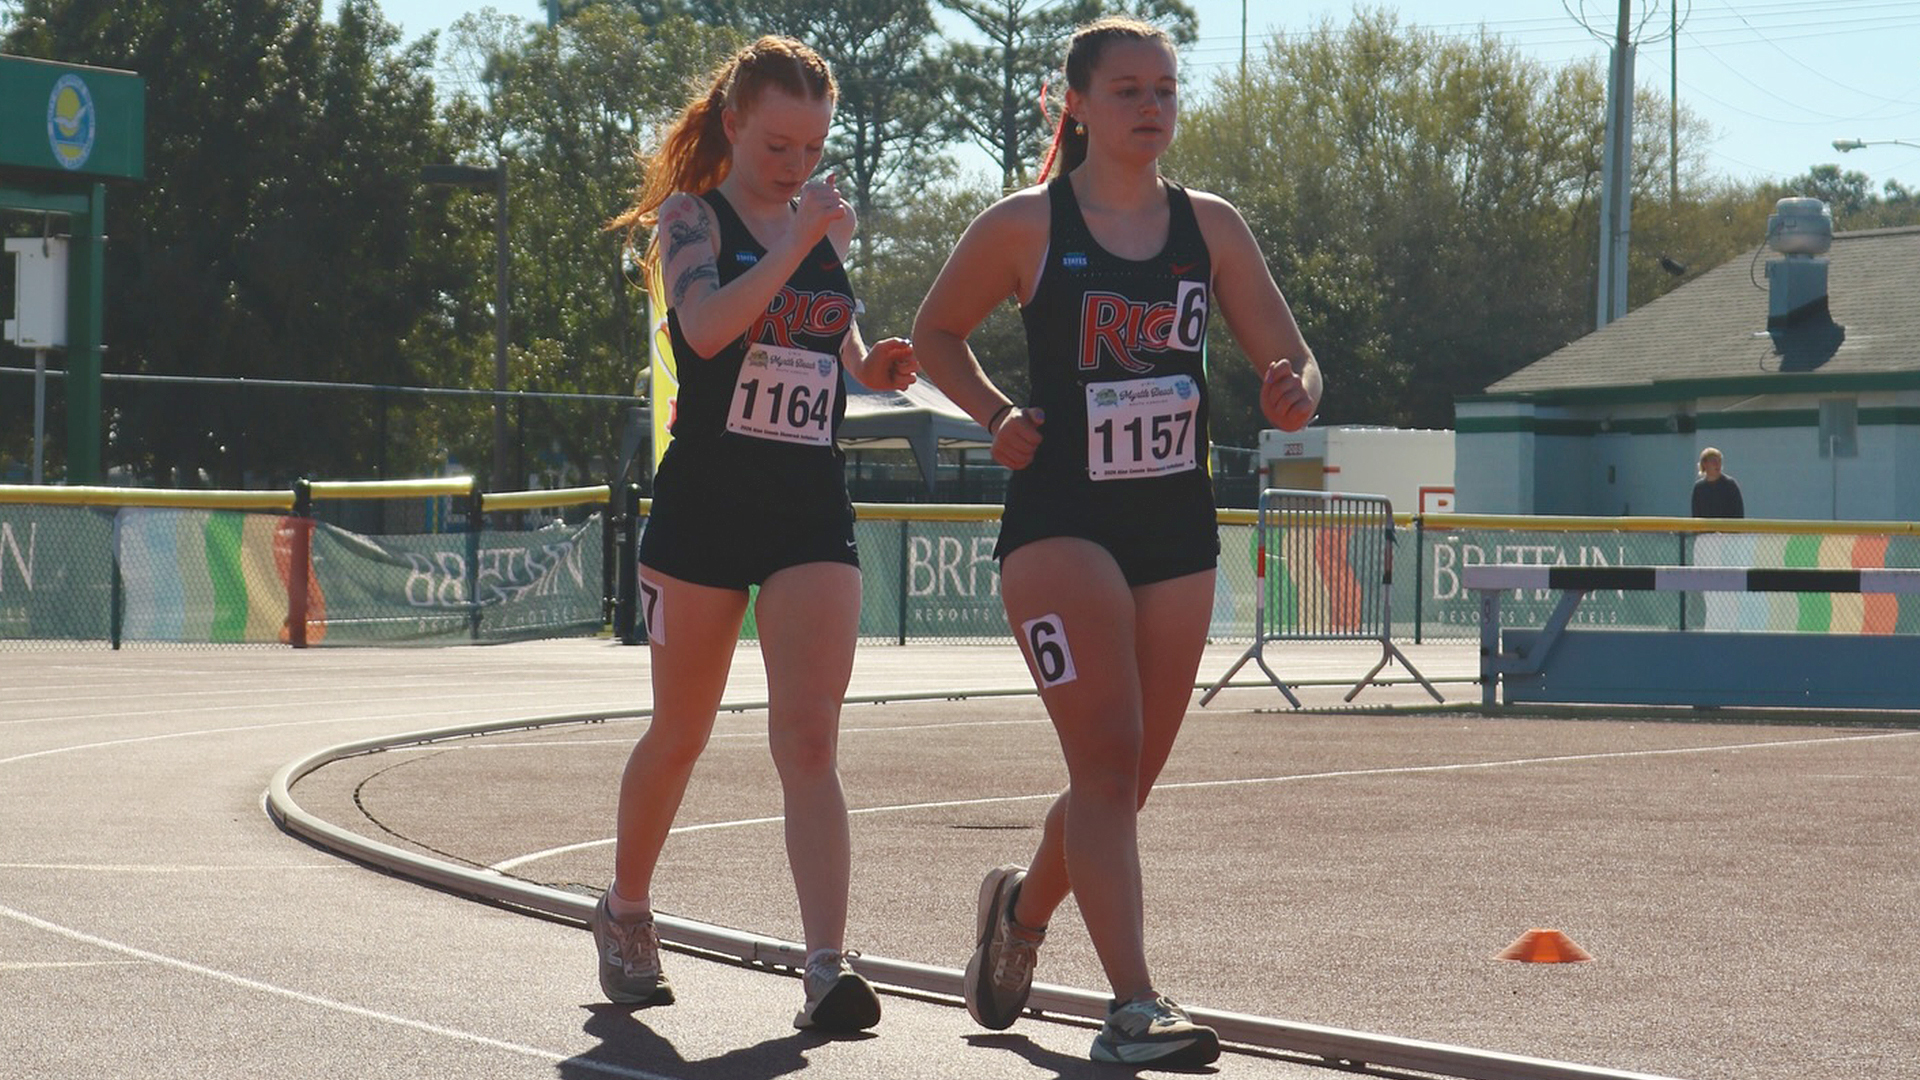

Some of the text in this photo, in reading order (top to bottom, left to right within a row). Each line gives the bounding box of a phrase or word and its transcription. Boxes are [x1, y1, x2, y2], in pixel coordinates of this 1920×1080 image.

[1178, 287, 1205, 347] 6
[741, 378, 829, 431] 1164
[1094, 410, 1192, 464] 1157
[640, 580, 658, 634] 7
[1030, 622, 1065, 682] 6
